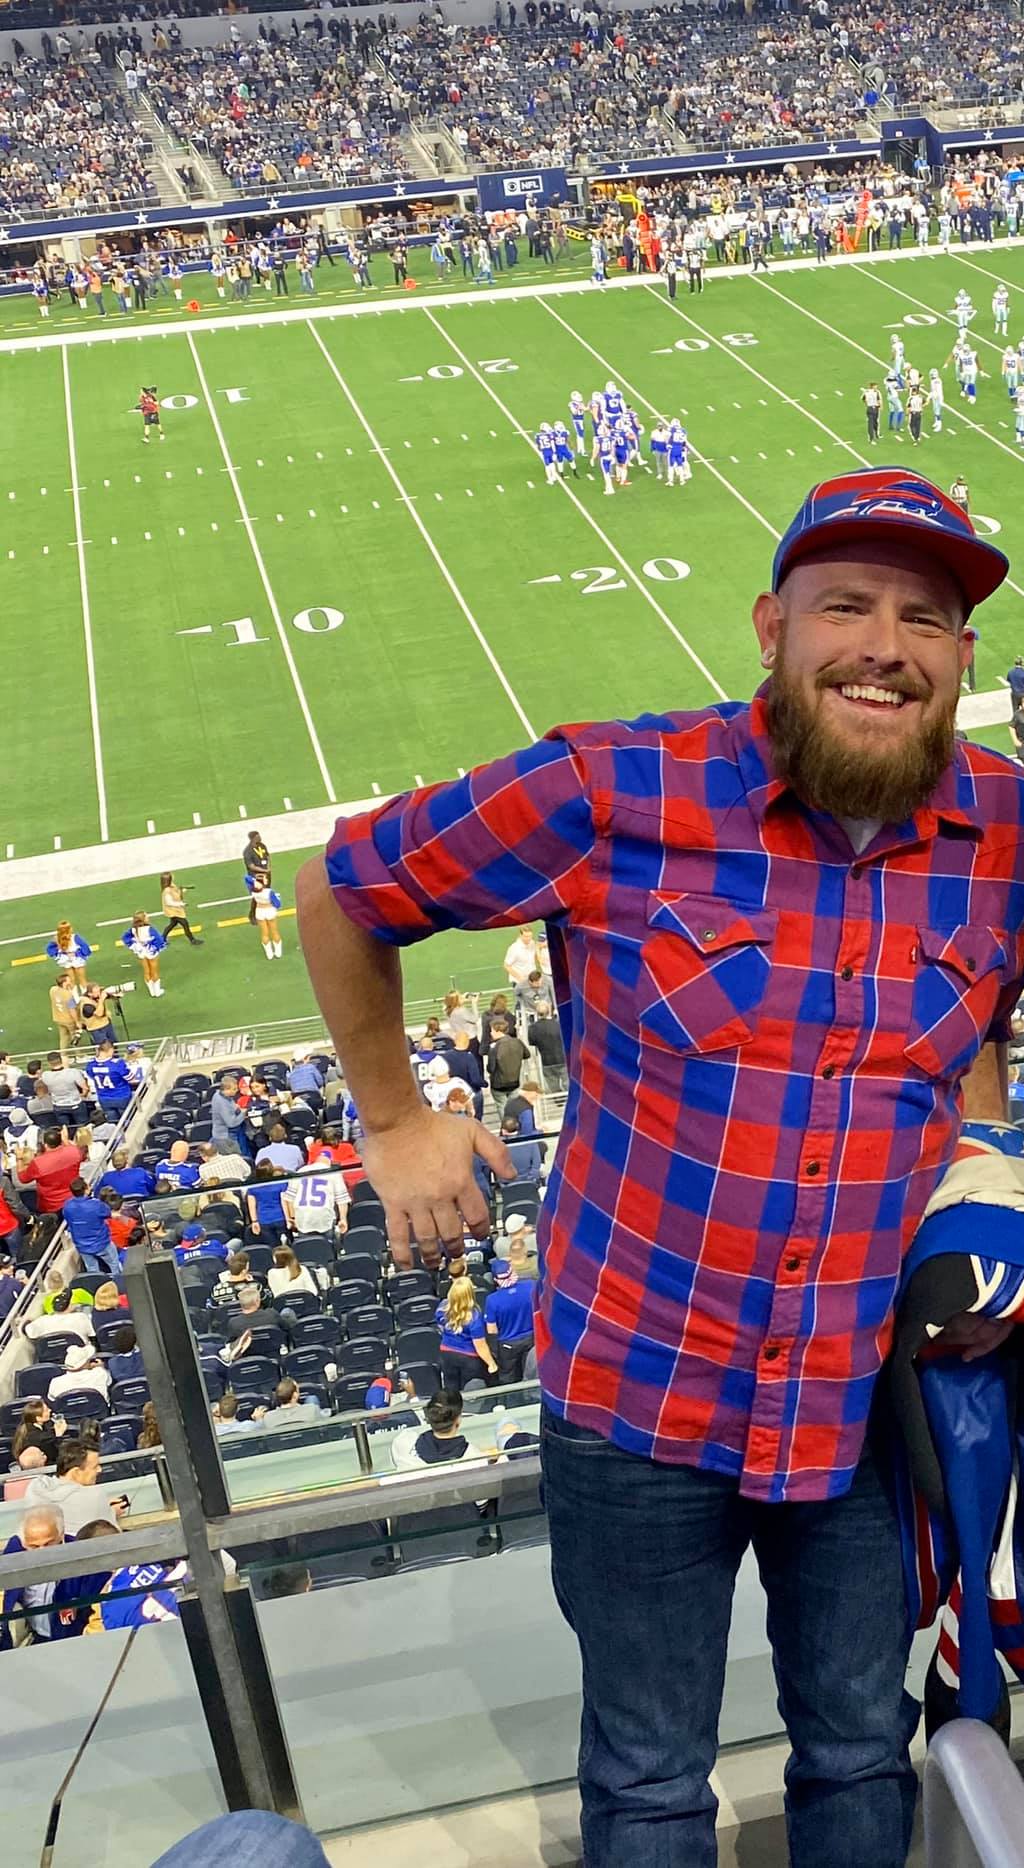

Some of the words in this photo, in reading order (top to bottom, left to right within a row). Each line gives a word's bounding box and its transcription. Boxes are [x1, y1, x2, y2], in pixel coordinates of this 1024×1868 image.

[521, 180, 539, 190] NFL
[570, 557, 691, 593] 20
[221, 606, 346, 646] 10
[94, 1075, 114, 1089] 14
[298, 1178, 330, 1208] 15
